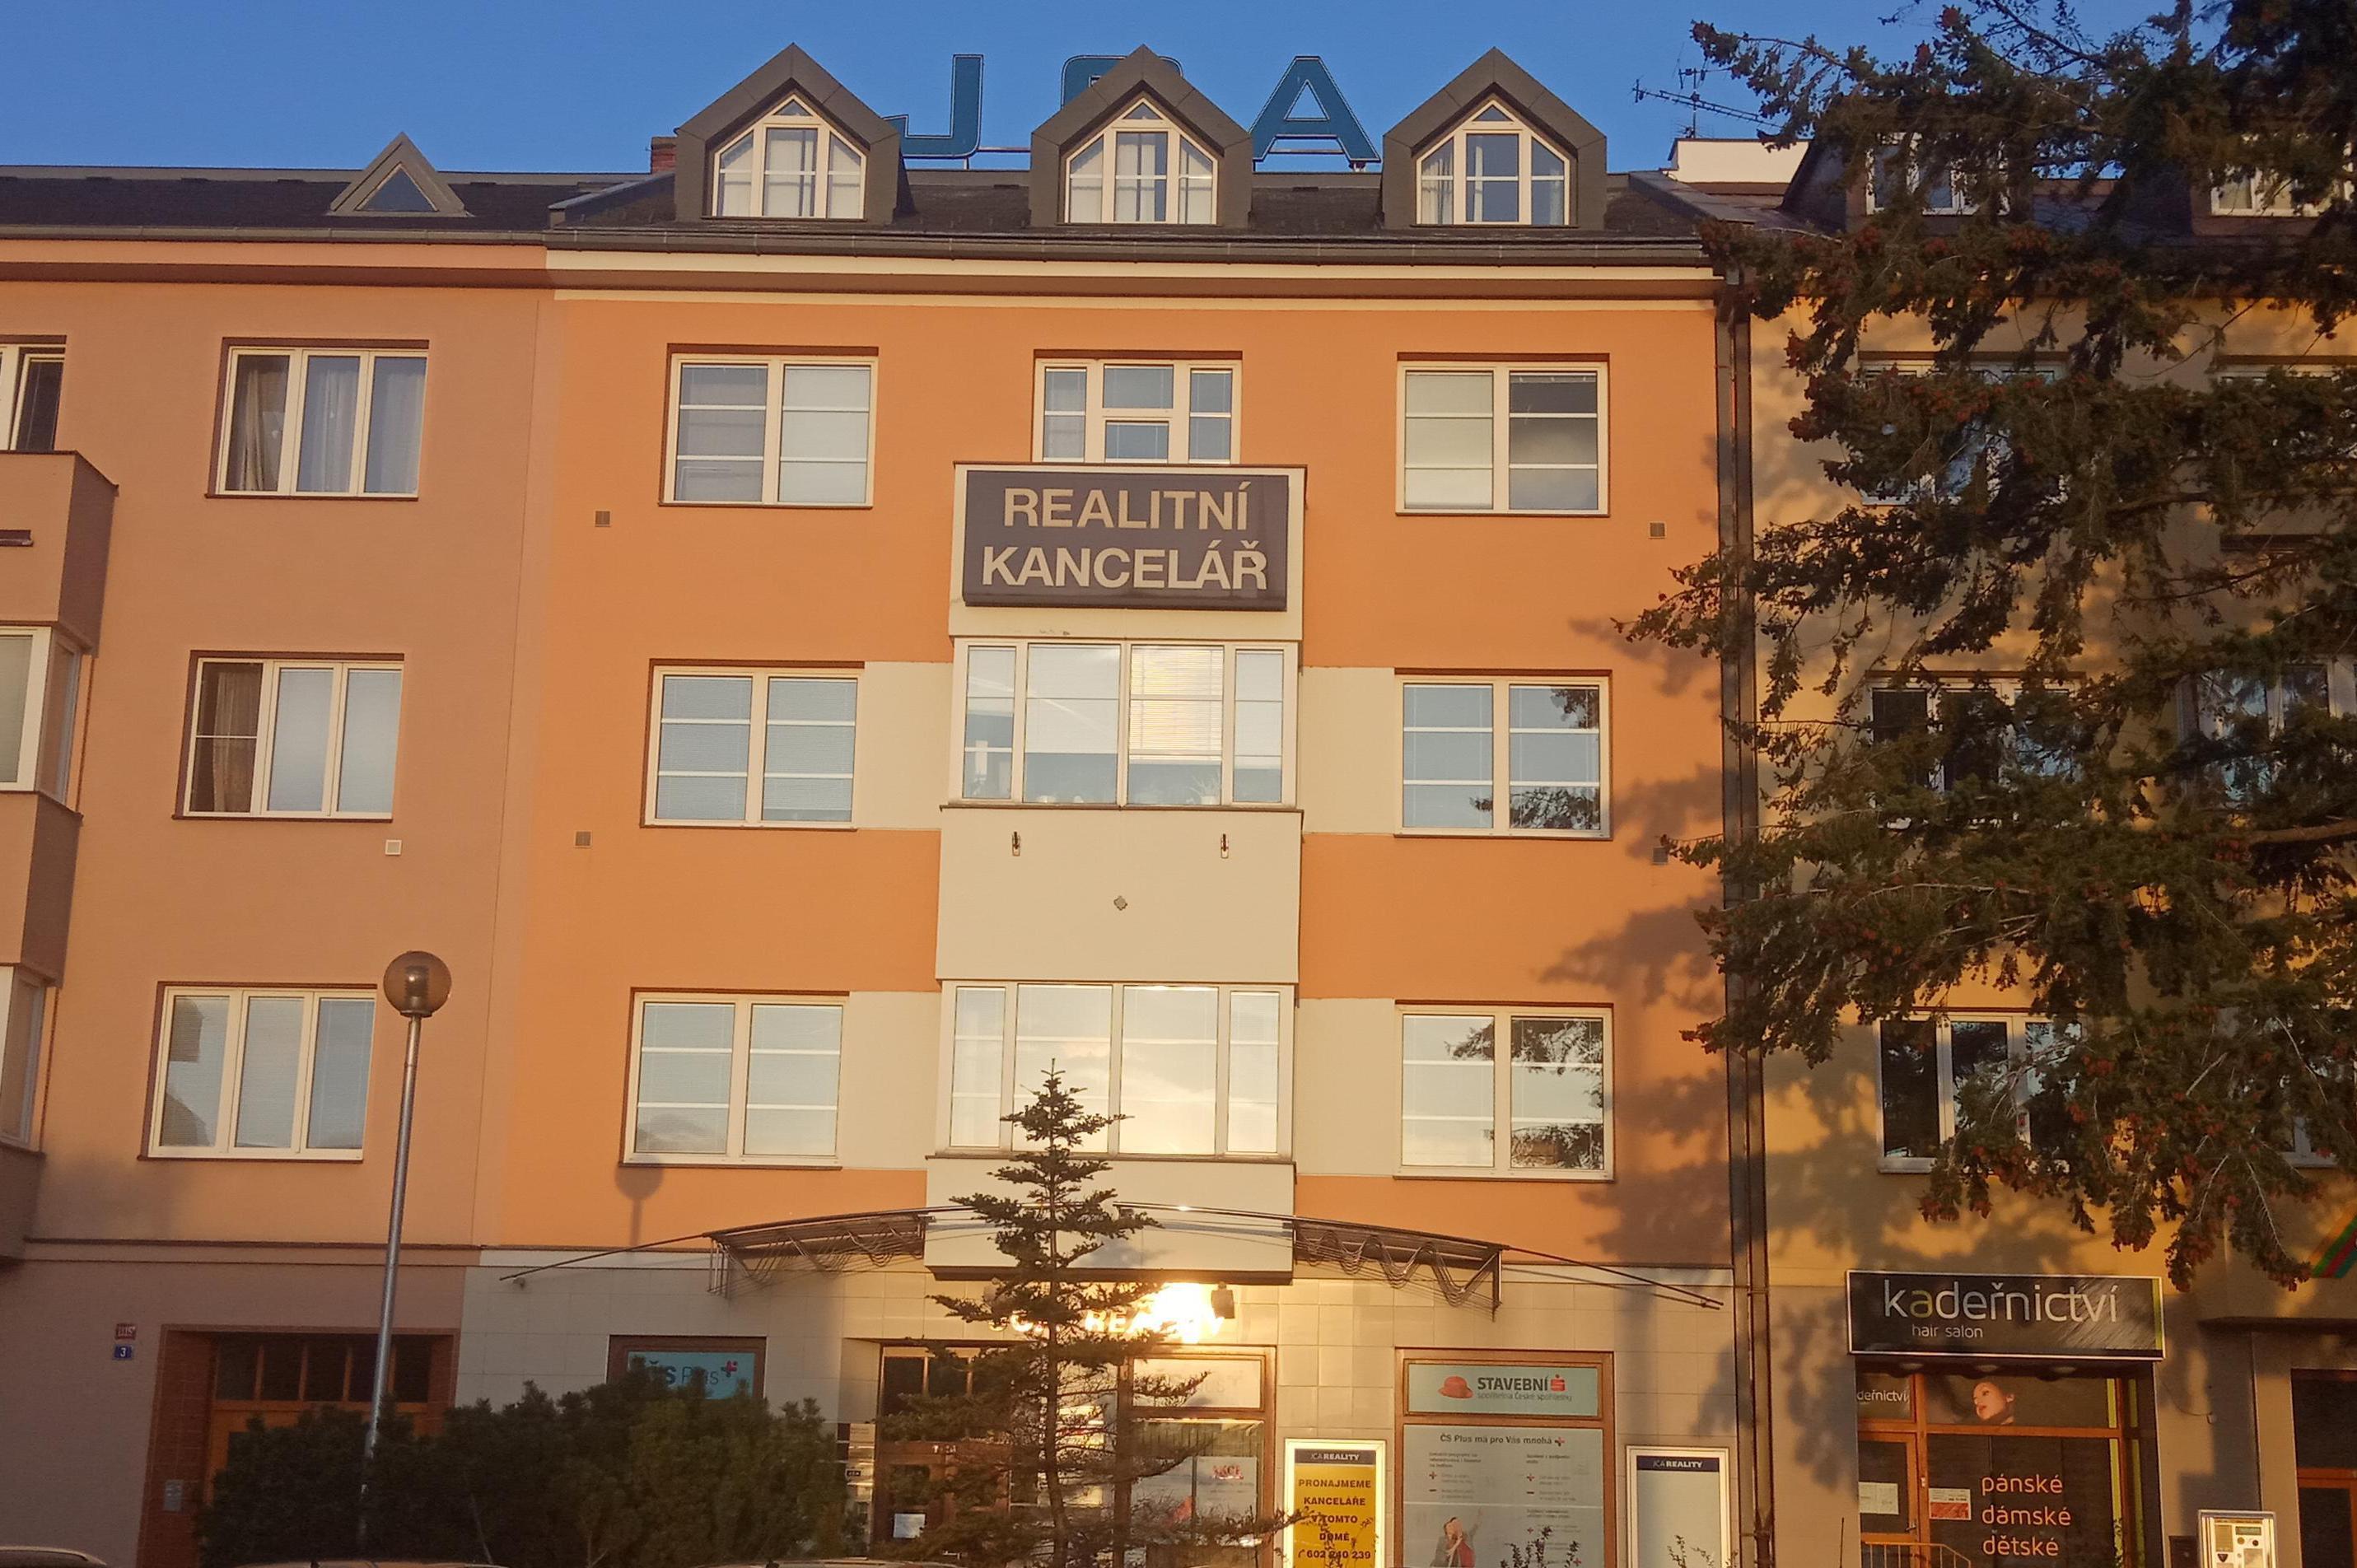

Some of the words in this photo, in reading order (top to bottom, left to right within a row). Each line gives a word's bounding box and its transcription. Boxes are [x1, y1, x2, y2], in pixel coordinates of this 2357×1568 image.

[1004, 481, 1252, 530] REALITNÍ
[982, 539, 1267, 590] KANCELÁŘ
[1883, 1279, 2118, 1323] kadeřnictví
[1911, 1323, 1939, 1337] hair
[1945, 1325, 1983, 1338] salon
[120, 1347, 126, 1357] 3
[1477, 1375, 1548, 1391] STAVEBNÍ
[1454, 1435, 1473, 1443] Plus
[1490, 1436, 1504, 1445] pro
[1323, 1453, 1360, 1461] REALITY
[1665, 1460, 1703, 1468] REALITY
[1299, 1479, 1371, 1488] PRONAJMEME
[1981, 1473, 2063, 1496] pánské
[1304, 1496, 1366, 1505] KANCELÁŘE
[1981, 1505, 2071, 1526] dámské
[1982, 1534, 2059, 1556] dětské
[1307, 1550, 1326, 1558] 602
[1351, 1551, 1370, 1559] 239
